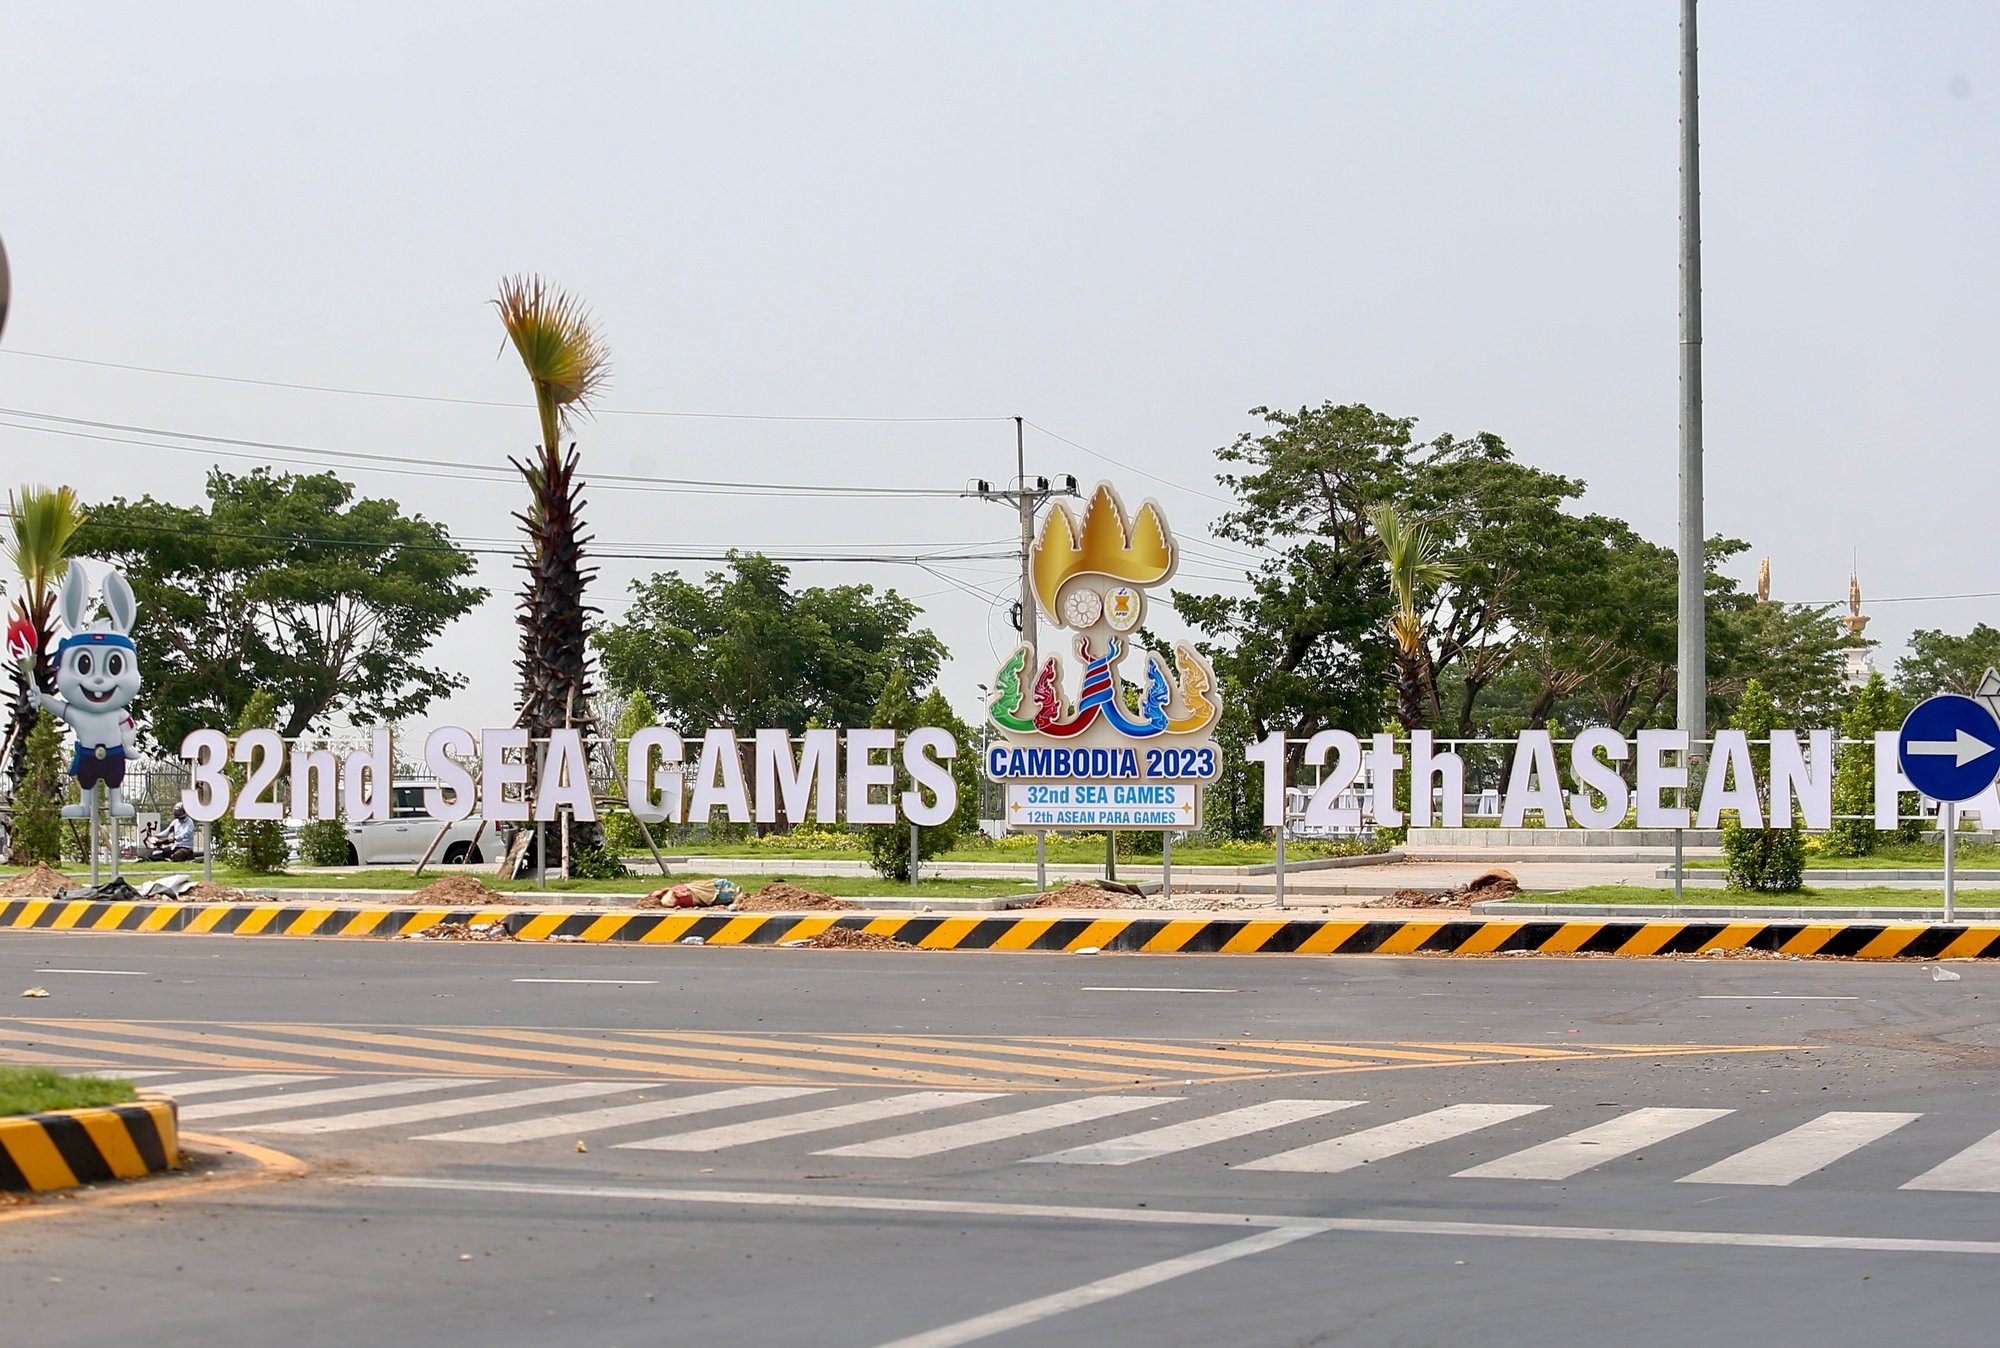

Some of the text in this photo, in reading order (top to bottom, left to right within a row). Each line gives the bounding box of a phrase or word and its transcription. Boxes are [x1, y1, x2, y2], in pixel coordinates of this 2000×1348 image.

[180, 726, 960, 826] 32nd SEA GAMES
[989, 747, 1215, 778] CAMBODIA 2023
[1245, 728, 1465, 828] 12th
[1500, 727, 1833, 829] ASEAN
[1027, 786, 1176, 805] 32nd SEA GAMES
[1027, 811, 1176, 824] 12th ASEAN PARA GAMES
